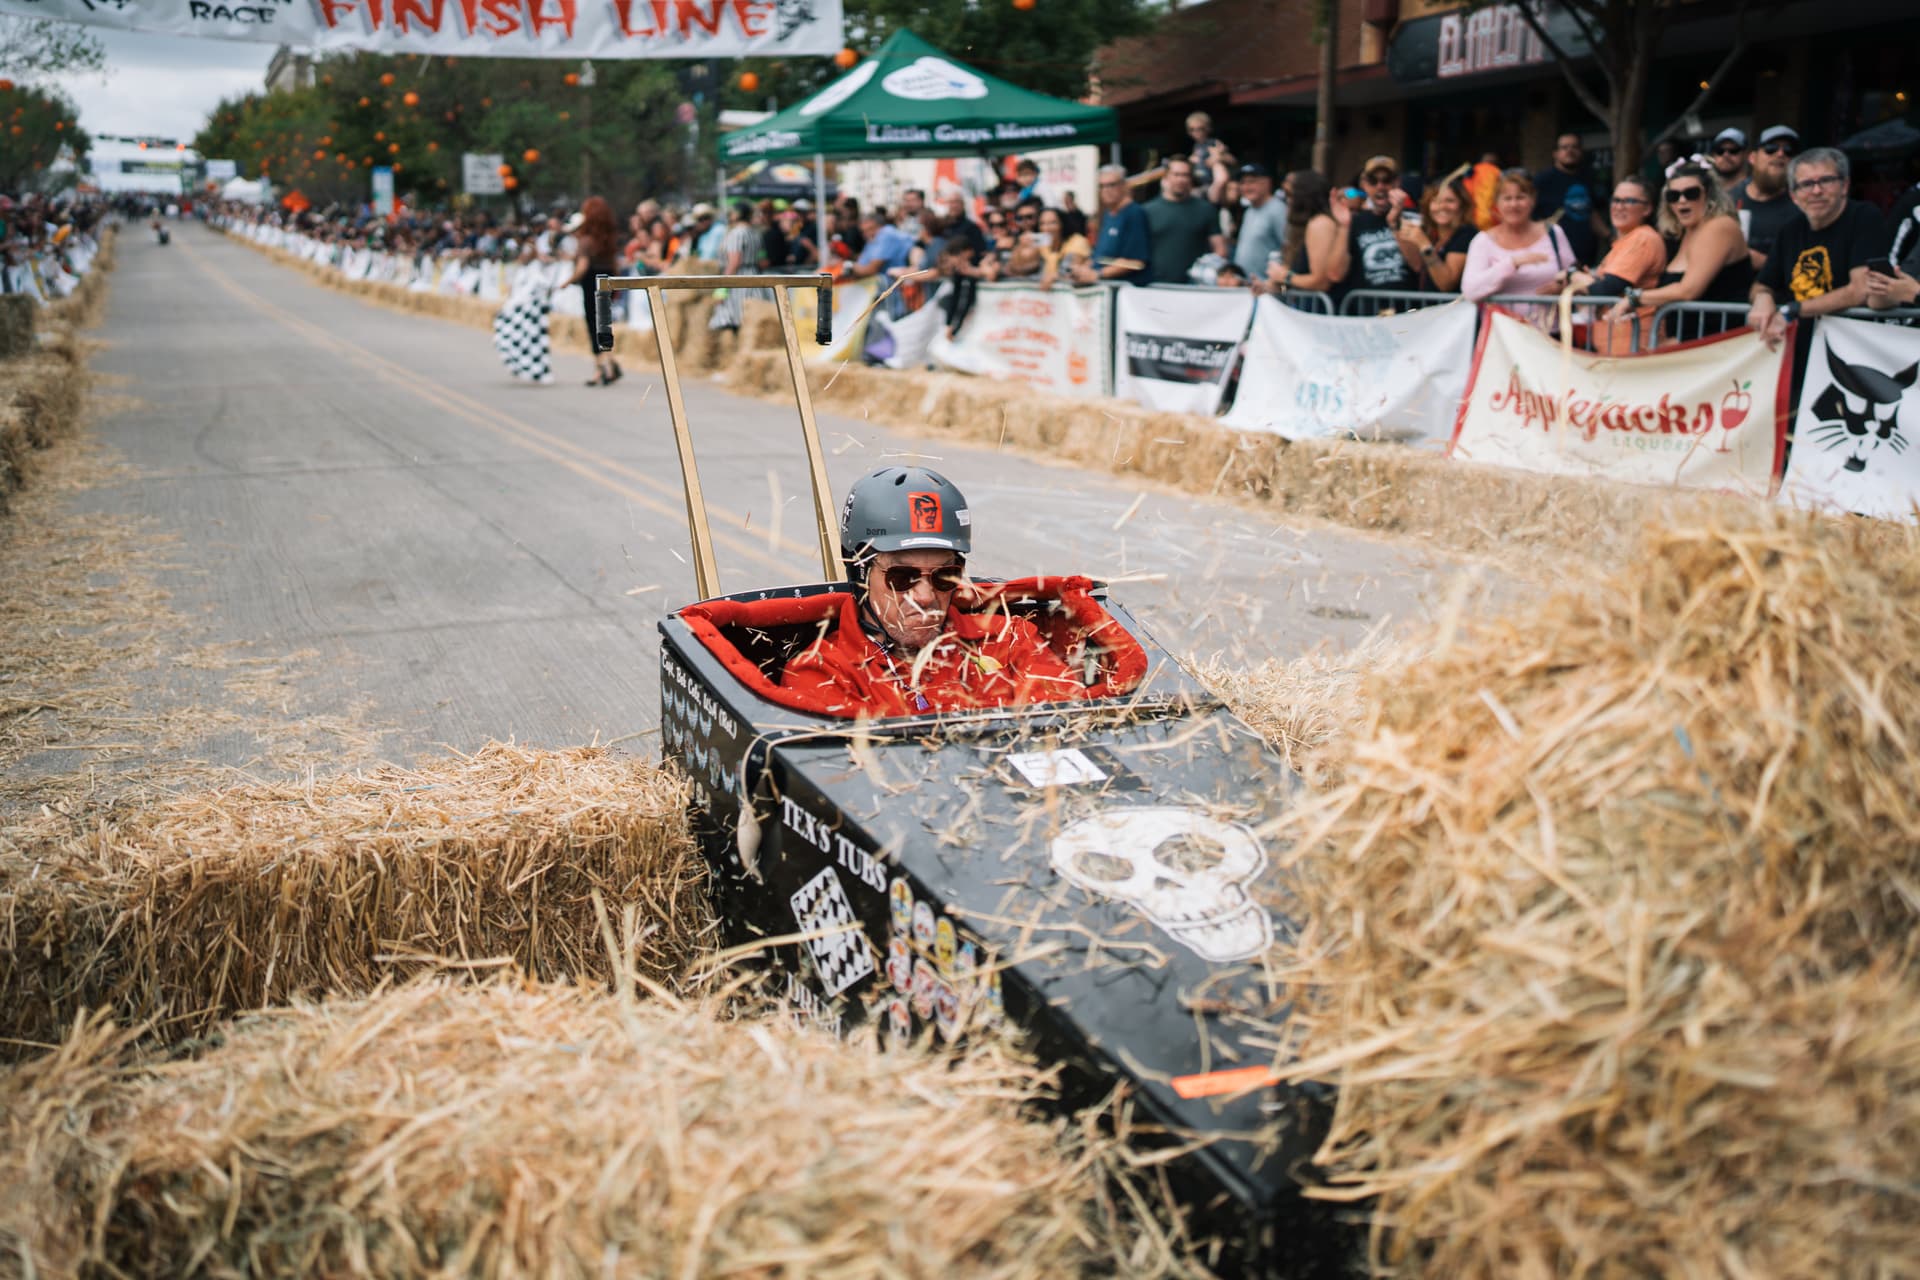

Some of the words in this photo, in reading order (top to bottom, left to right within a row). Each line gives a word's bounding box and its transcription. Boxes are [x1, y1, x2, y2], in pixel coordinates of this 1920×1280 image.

[190, 1, 276, 24] RACE
[318, 0, 577, 39] FINISH
[615, 0, 775, 40] LINE
[834, 832, 888, 894] TUBS
